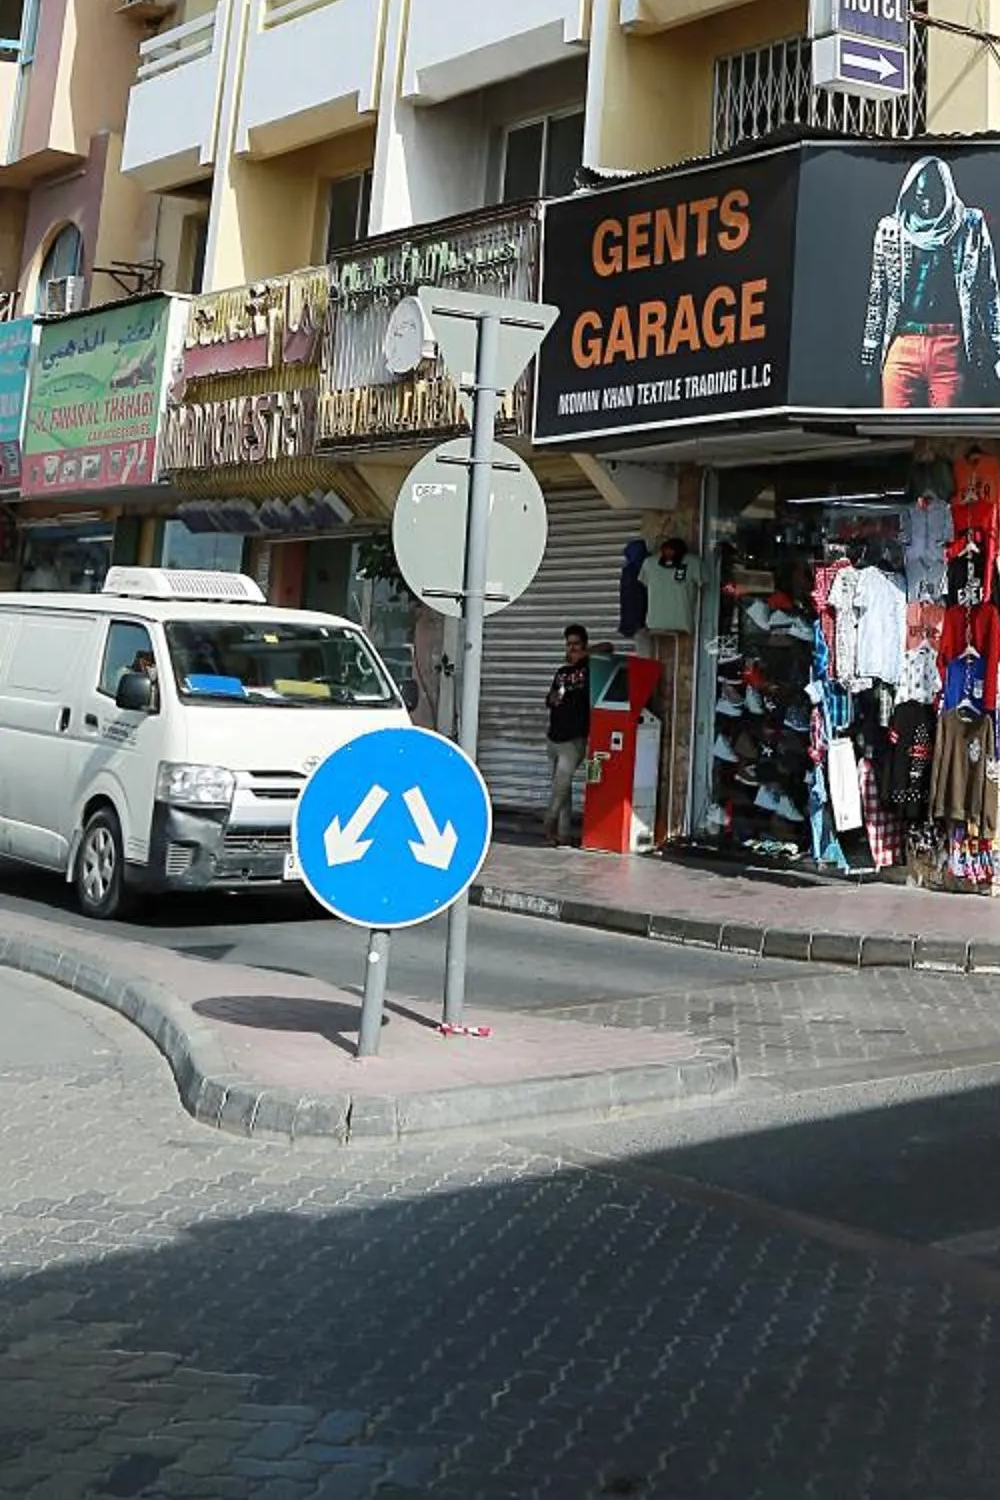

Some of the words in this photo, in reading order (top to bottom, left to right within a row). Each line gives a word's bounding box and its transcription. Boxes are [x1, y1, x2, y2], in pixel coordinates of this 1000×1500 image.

[591, 189, 751, 277] GENTS
[571, 278, 768, 369] GARAGE
[602, 385, 634, 410] KHAN
[637, 378, 681, 404] TEXTILE
[684, 369, 737, 399] TRADING
